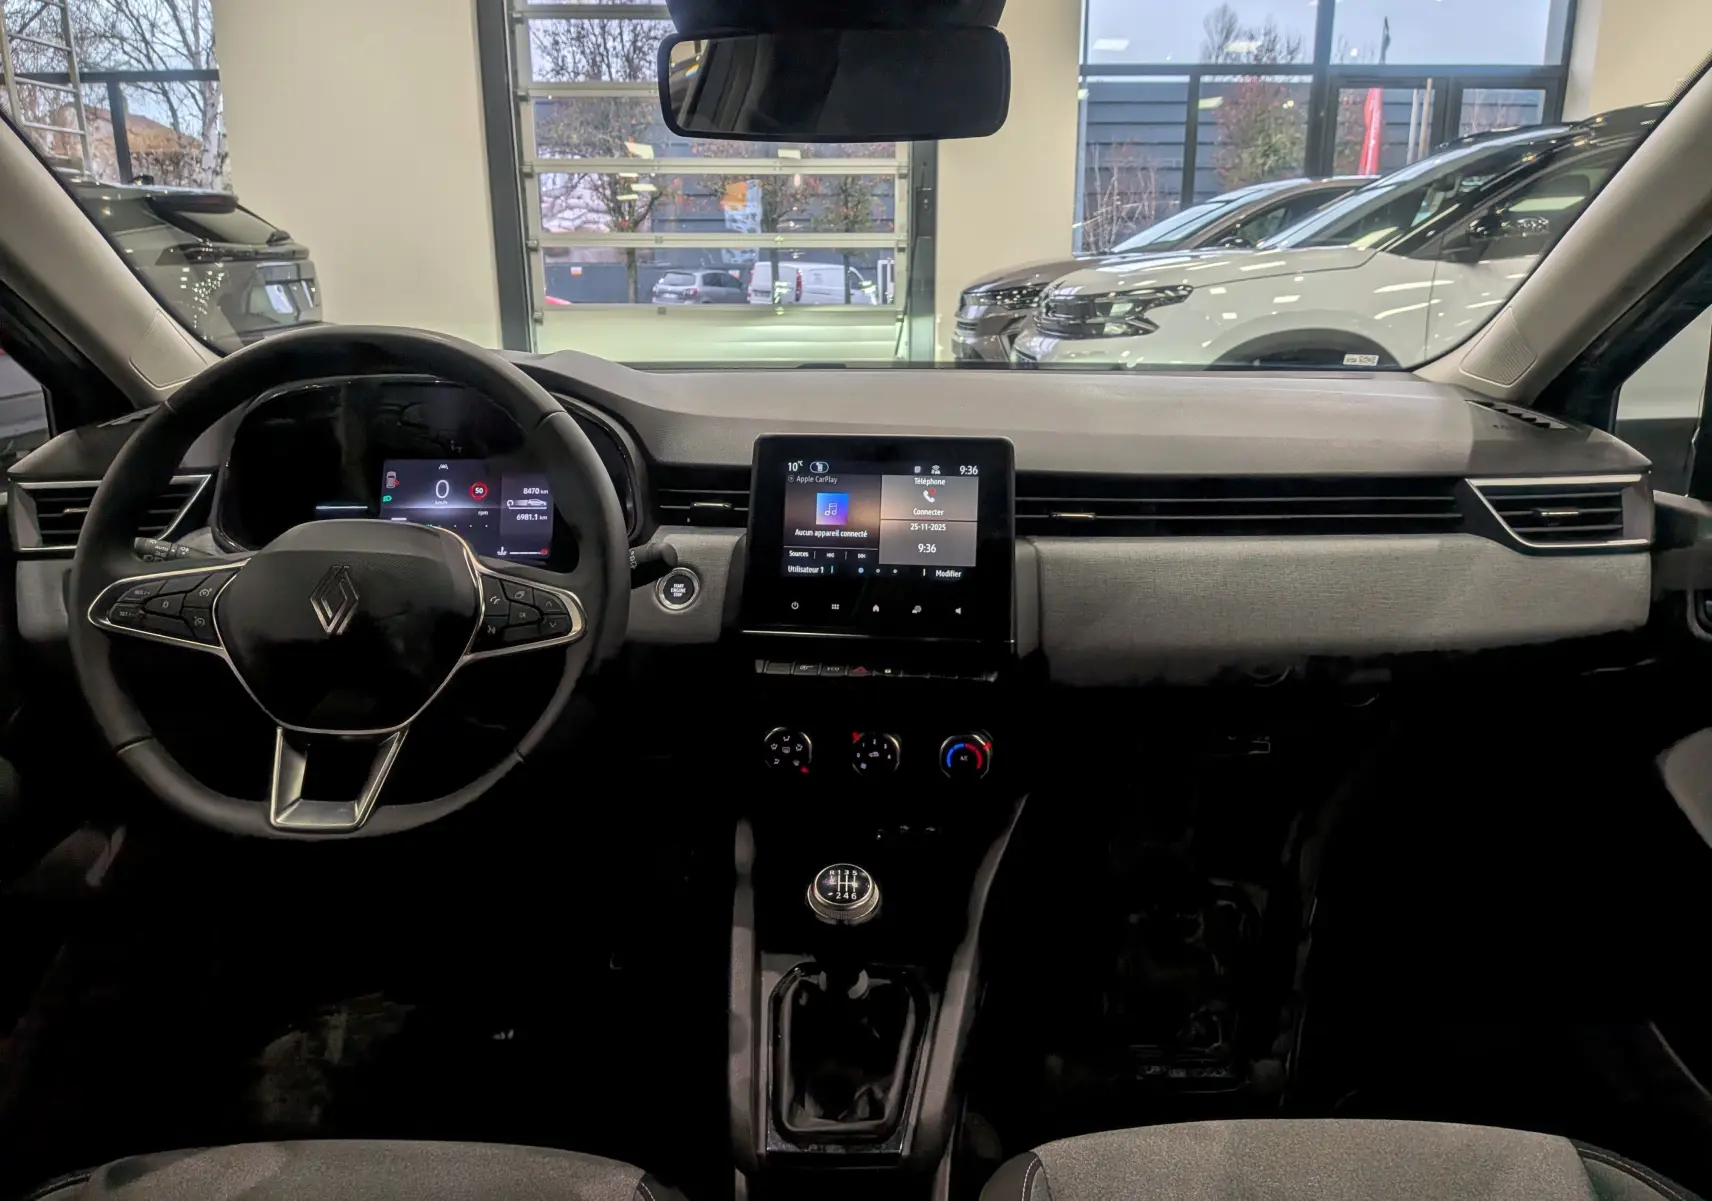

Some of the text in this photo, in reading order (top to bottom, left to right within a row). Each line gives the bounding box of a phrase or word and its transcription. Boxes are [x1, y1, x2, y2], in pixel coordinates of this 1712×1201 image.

[959, 465, 979, 475] 9:36
[796, 475, 838, 485] Apple CarPlay
[914, 477, 946, 487] Téléphone
[435, 479, 450, 499] 0
[522, 487, 540, 495] 8470
[516, 513, 539, 521] 6981.1
[913, 508, 944, 517] Connecter
[910, 523, 947, 532] 25-11-2025
[794, 528, 868, 539] Aucun appareil connecté
[917, 543, 937, 554] 9:36
[788, 550, 809, 558] Sources
[787, 564, 824, 574] Utilisateur 1
[935, 569, 962, 579] Modifier
